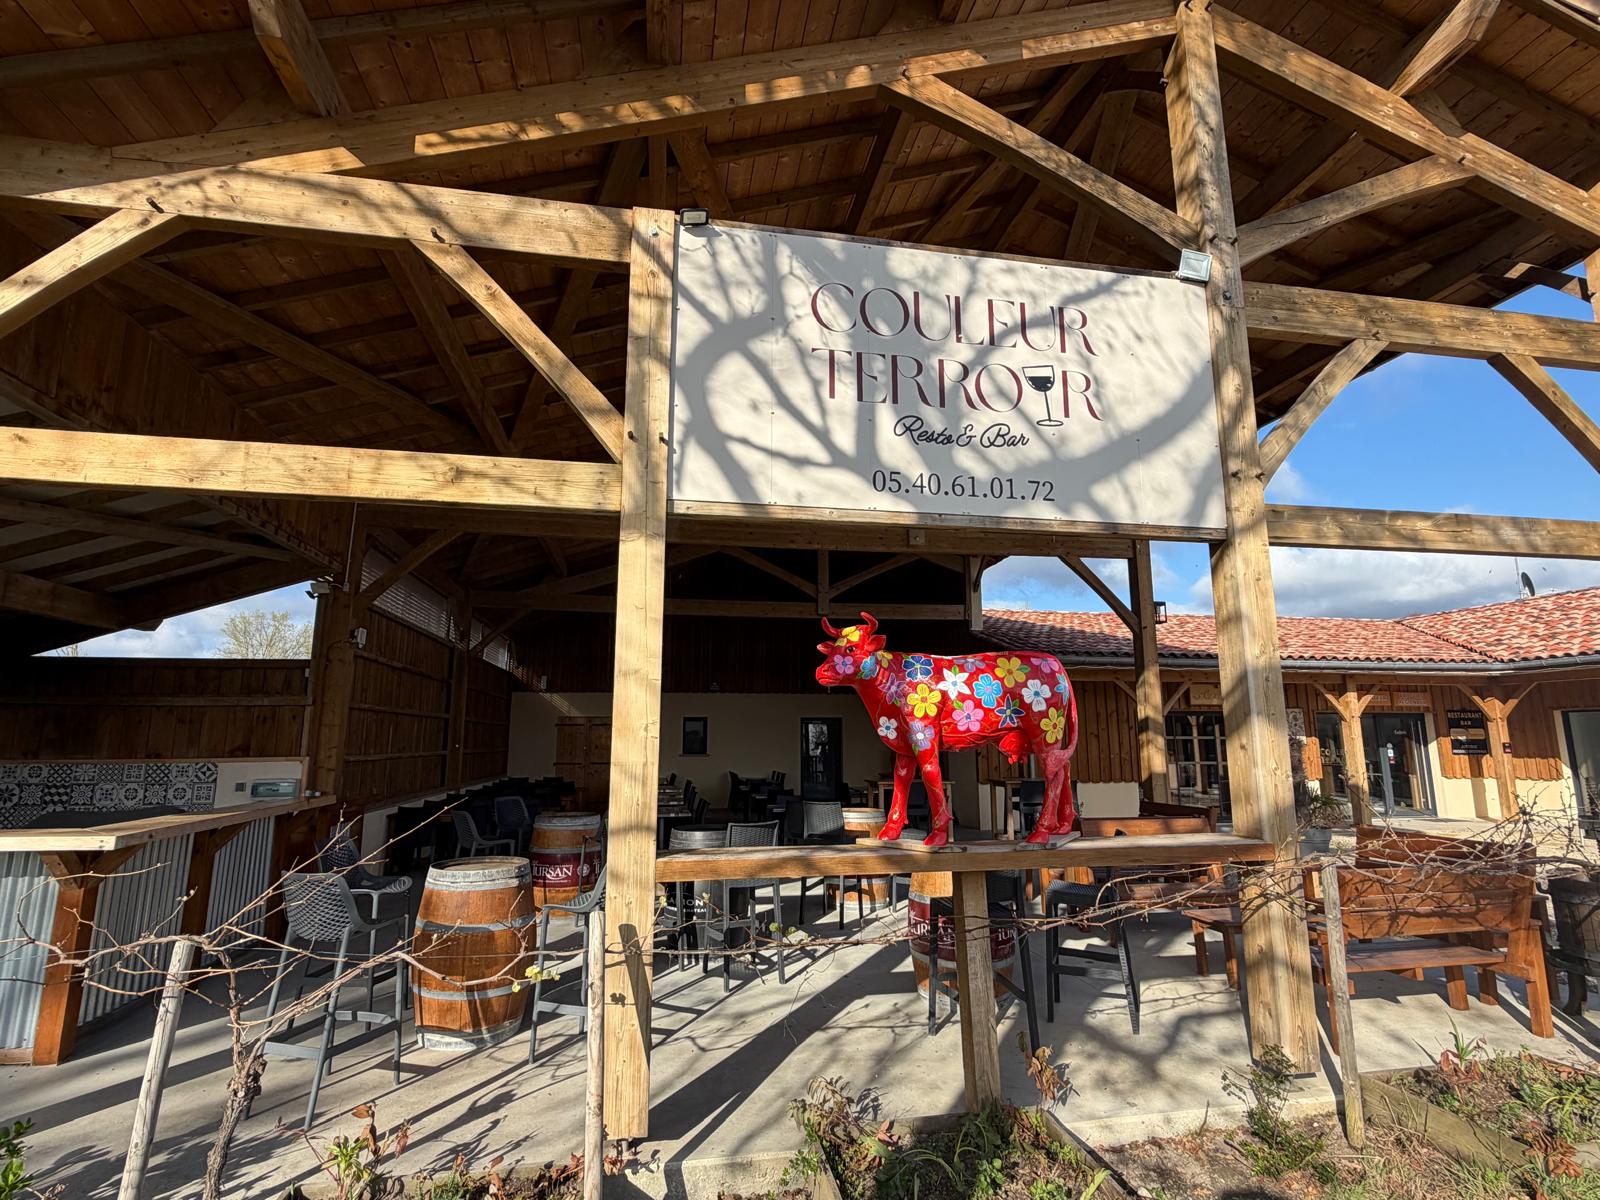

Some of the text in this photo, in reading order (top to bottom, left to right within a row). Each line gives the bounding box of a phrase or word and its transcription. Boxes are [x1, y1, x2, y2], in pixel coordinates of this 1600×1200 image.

[810, 282, 1099, 357] COULEUR
[893, 415, 1030, 448] Resto & Bar
[872, 469, 1056, 502] 05.40.61.01.72
